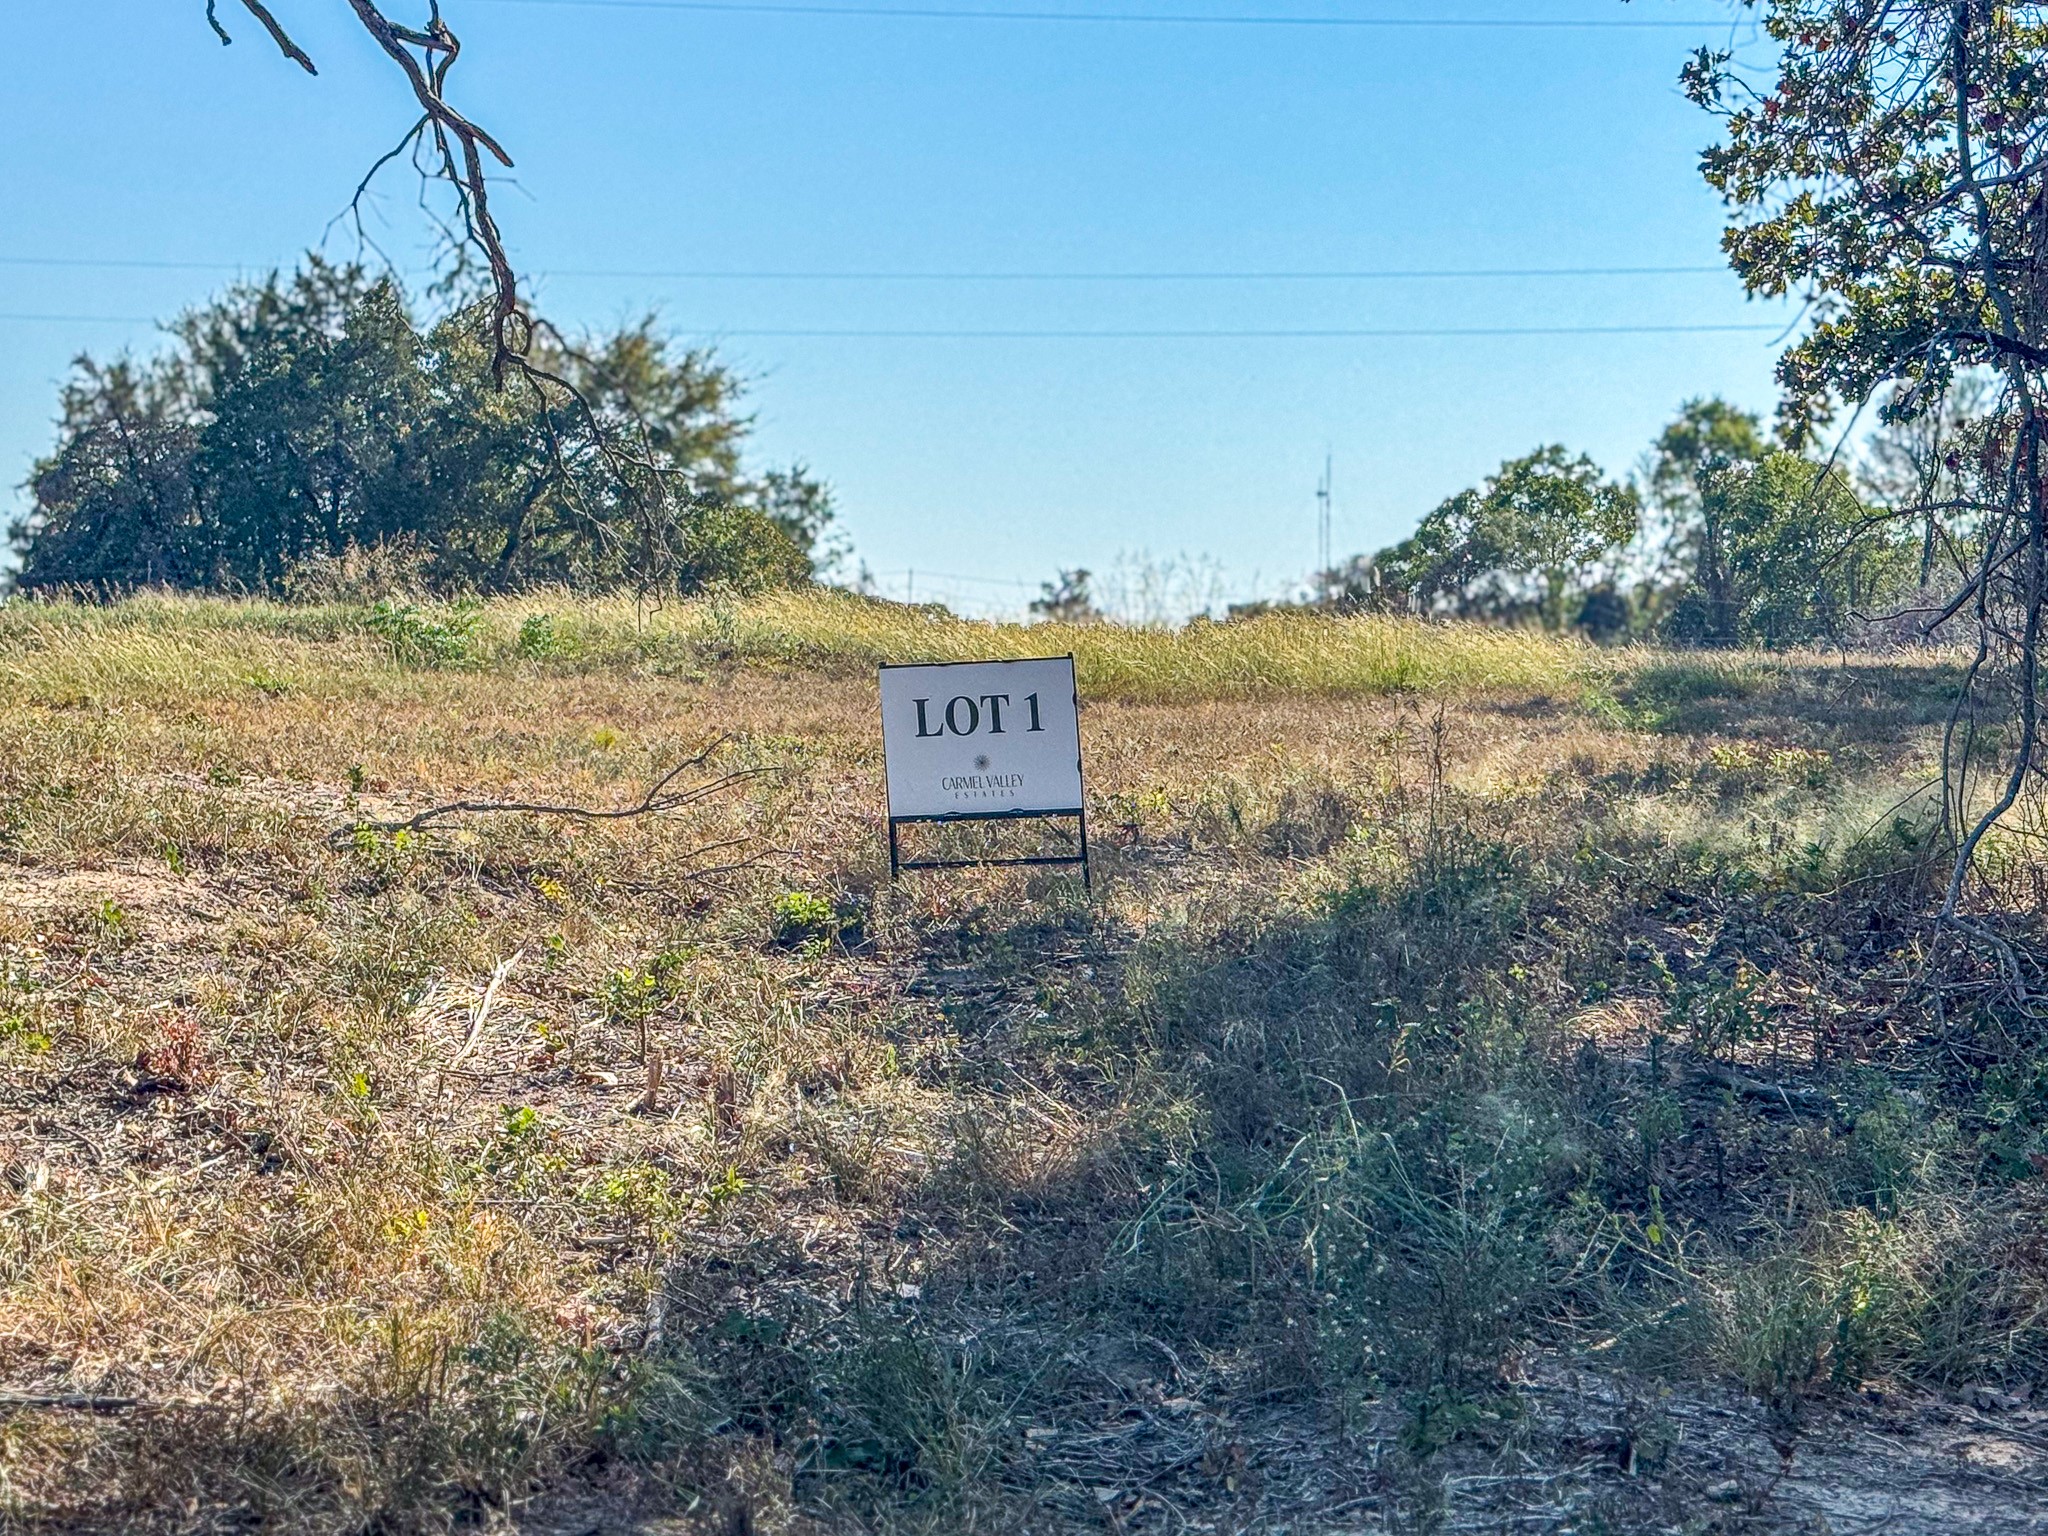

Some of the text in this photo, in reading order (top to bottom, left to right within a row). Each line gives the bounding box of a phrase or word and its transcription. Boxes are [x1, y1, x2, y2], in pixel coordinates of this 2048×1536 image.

[912, 692, 1046, 738] LOT 1
[942, 774, 1024, 791] CARMEL VALLEY
[954, 789, 1015, 799] ESTATES
